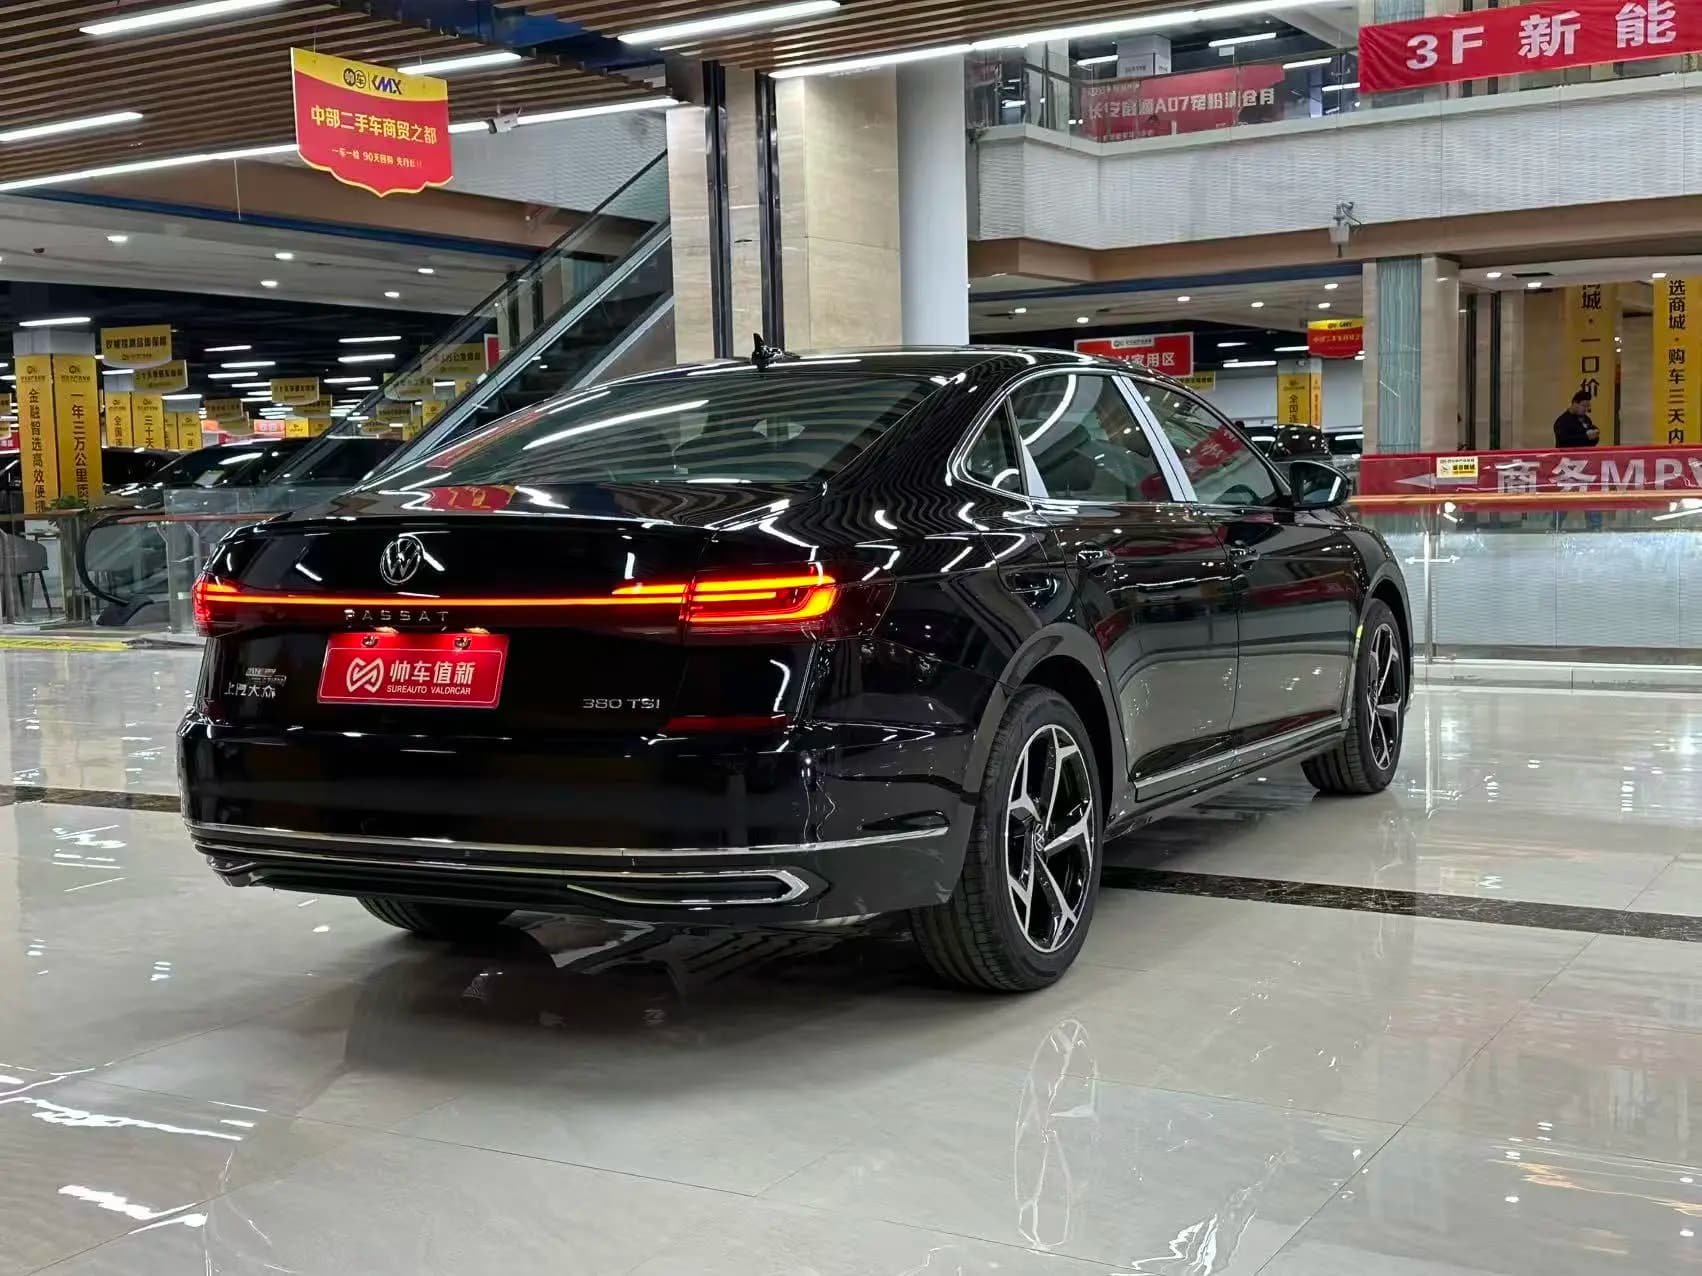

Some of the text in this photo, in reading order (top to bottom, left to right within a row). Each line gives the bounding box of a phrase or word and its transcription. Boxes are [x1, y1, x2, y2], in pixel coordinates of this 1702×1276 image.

[311, 104, 437, 145] 中部二手车商贸之都
[1122, 352, 1175, 367] 家用区
[344, 609, 449, 622] PASSAT
[390, 660, 476, 685] 帅车值新
[224, 682, 276, 698] 上汽大众
[387, 685, 428, 694] SUREAUTO
[583, 698, 660, 709] 380 TSI
